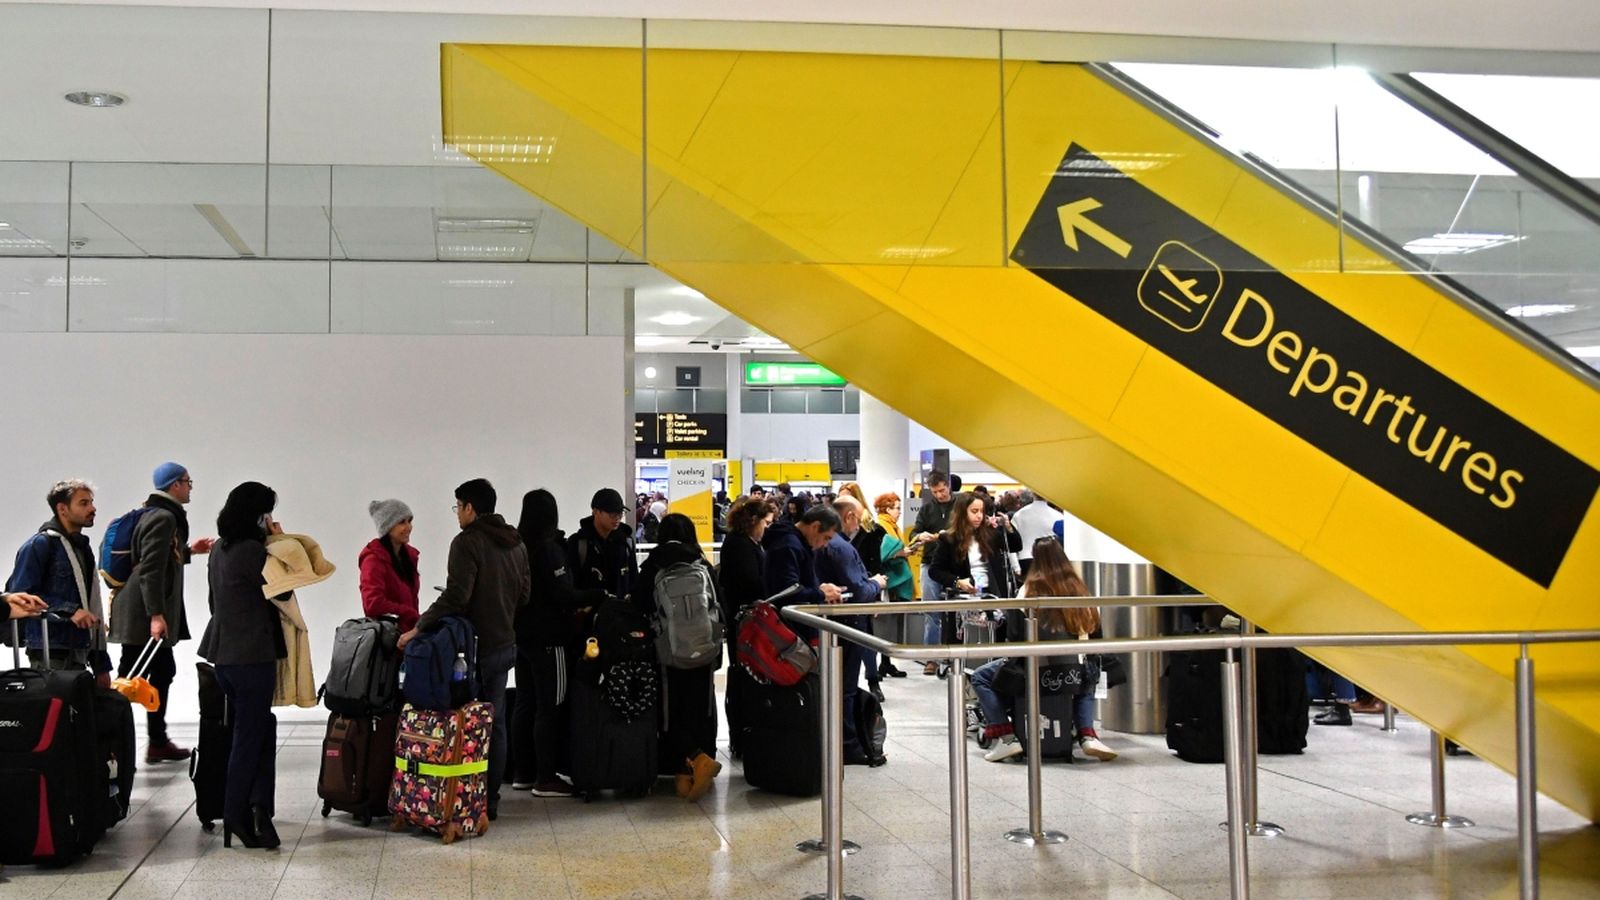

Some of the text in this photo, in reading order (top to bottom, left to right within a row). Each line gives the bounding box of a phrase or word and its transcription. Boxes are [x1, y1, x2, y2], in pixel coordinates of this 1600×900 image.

[1221, 288, 1525, 510] Departures
[687, 428, 708, 436] parking
[676, 467, 705, 478] vueling
